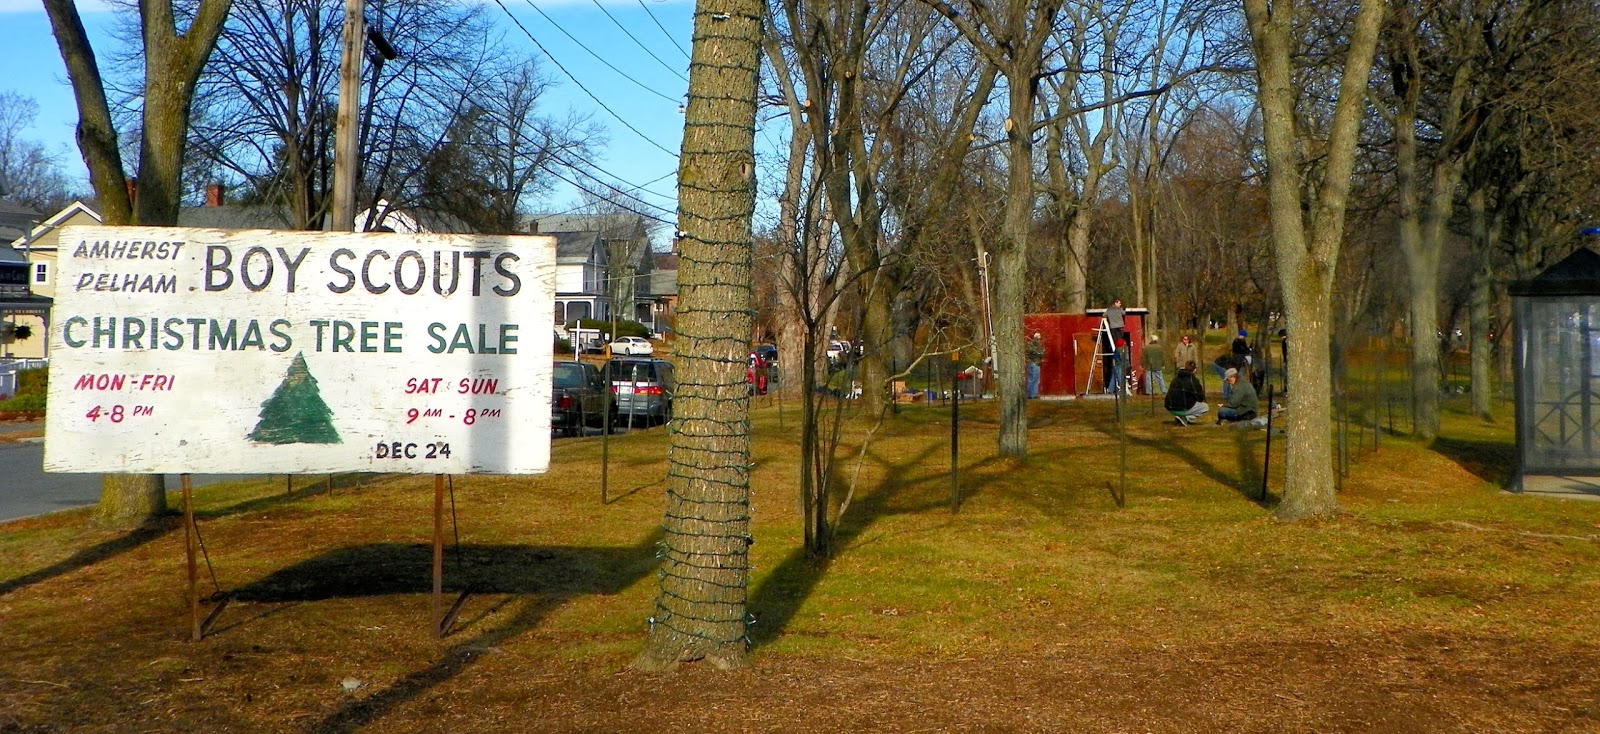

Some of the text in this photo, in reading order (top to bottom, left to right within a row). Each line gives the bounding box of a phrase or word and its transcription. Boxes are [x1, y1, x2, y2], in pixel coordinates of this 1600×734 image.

[73, 240, 186, 260] AMHERST
[204, 245, 522, 297] BOY SCOUTS
[75, 272, 177, 293] PELHAM
[63, 315, 519, 355] CHRISTMAS TREE SALE
[404, 378, 499, 395] SAT SUN
[132, 405, 154, 417] PM
[375, 442, 452, 459] DEC 24
